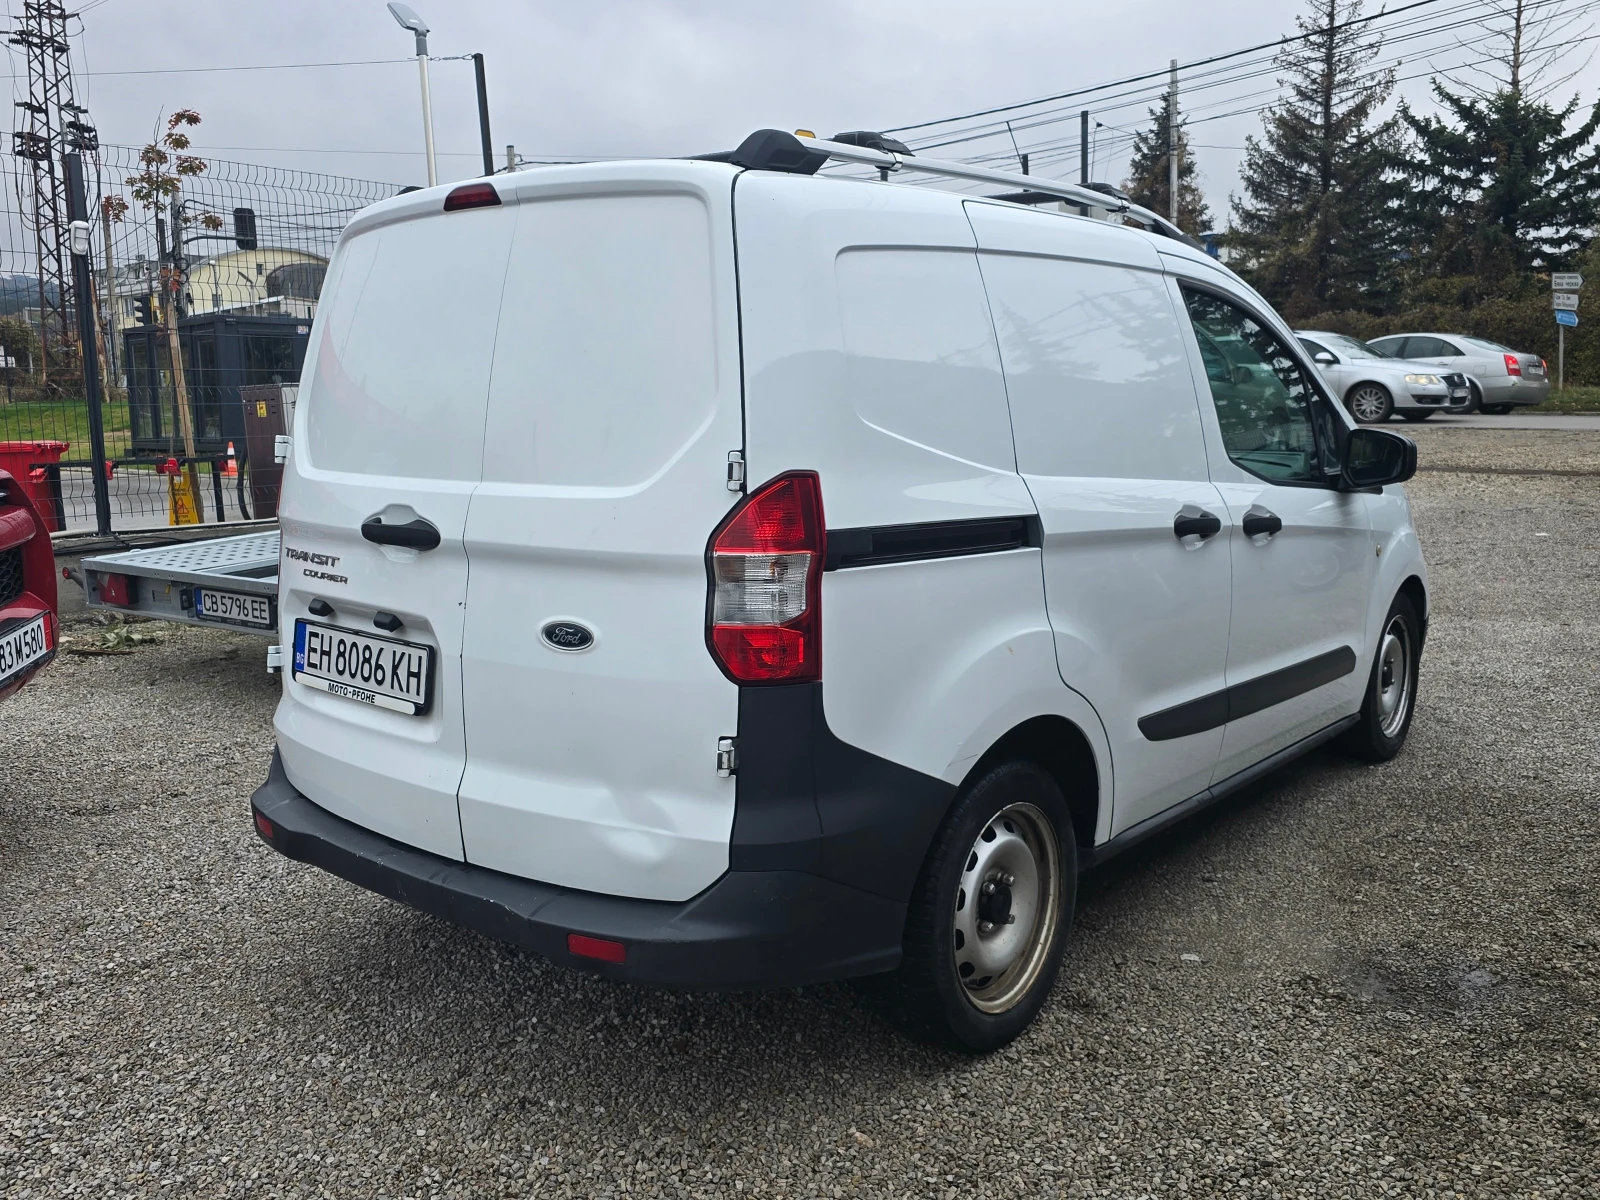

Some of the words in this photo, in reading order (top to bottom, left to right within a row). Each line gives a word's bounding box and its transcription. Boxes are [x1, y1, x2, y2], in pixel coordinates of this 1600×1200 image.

[285, 547, 340, 567] TRANSIT
[303, 569, 348, 584] COURIER
[552, 627, 581, 644] Ford
